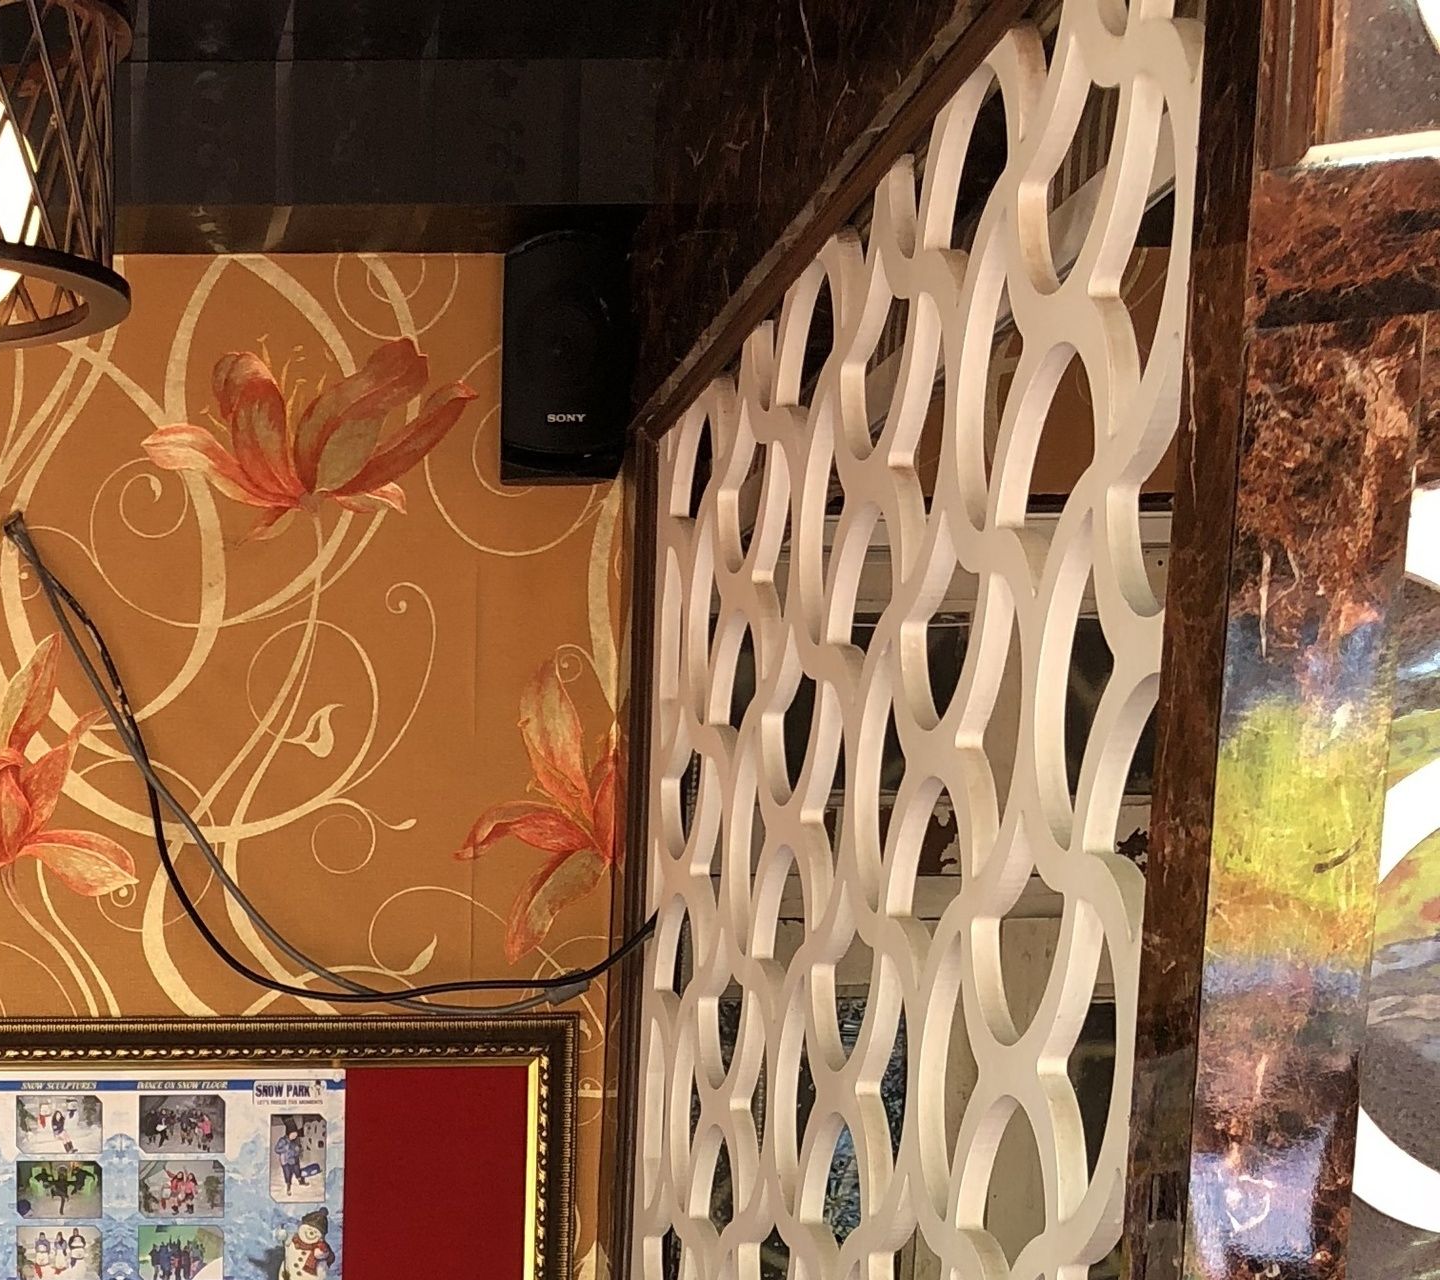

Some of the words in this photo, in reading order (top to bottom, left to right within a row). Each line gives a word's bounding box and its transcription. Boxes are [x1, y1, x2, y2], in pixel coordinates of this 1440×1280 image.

[547, 413, 586, 423] SONY
[255, 1084, 284, 1098] SNOW
[286, 1084, 311, 1098] PARK
